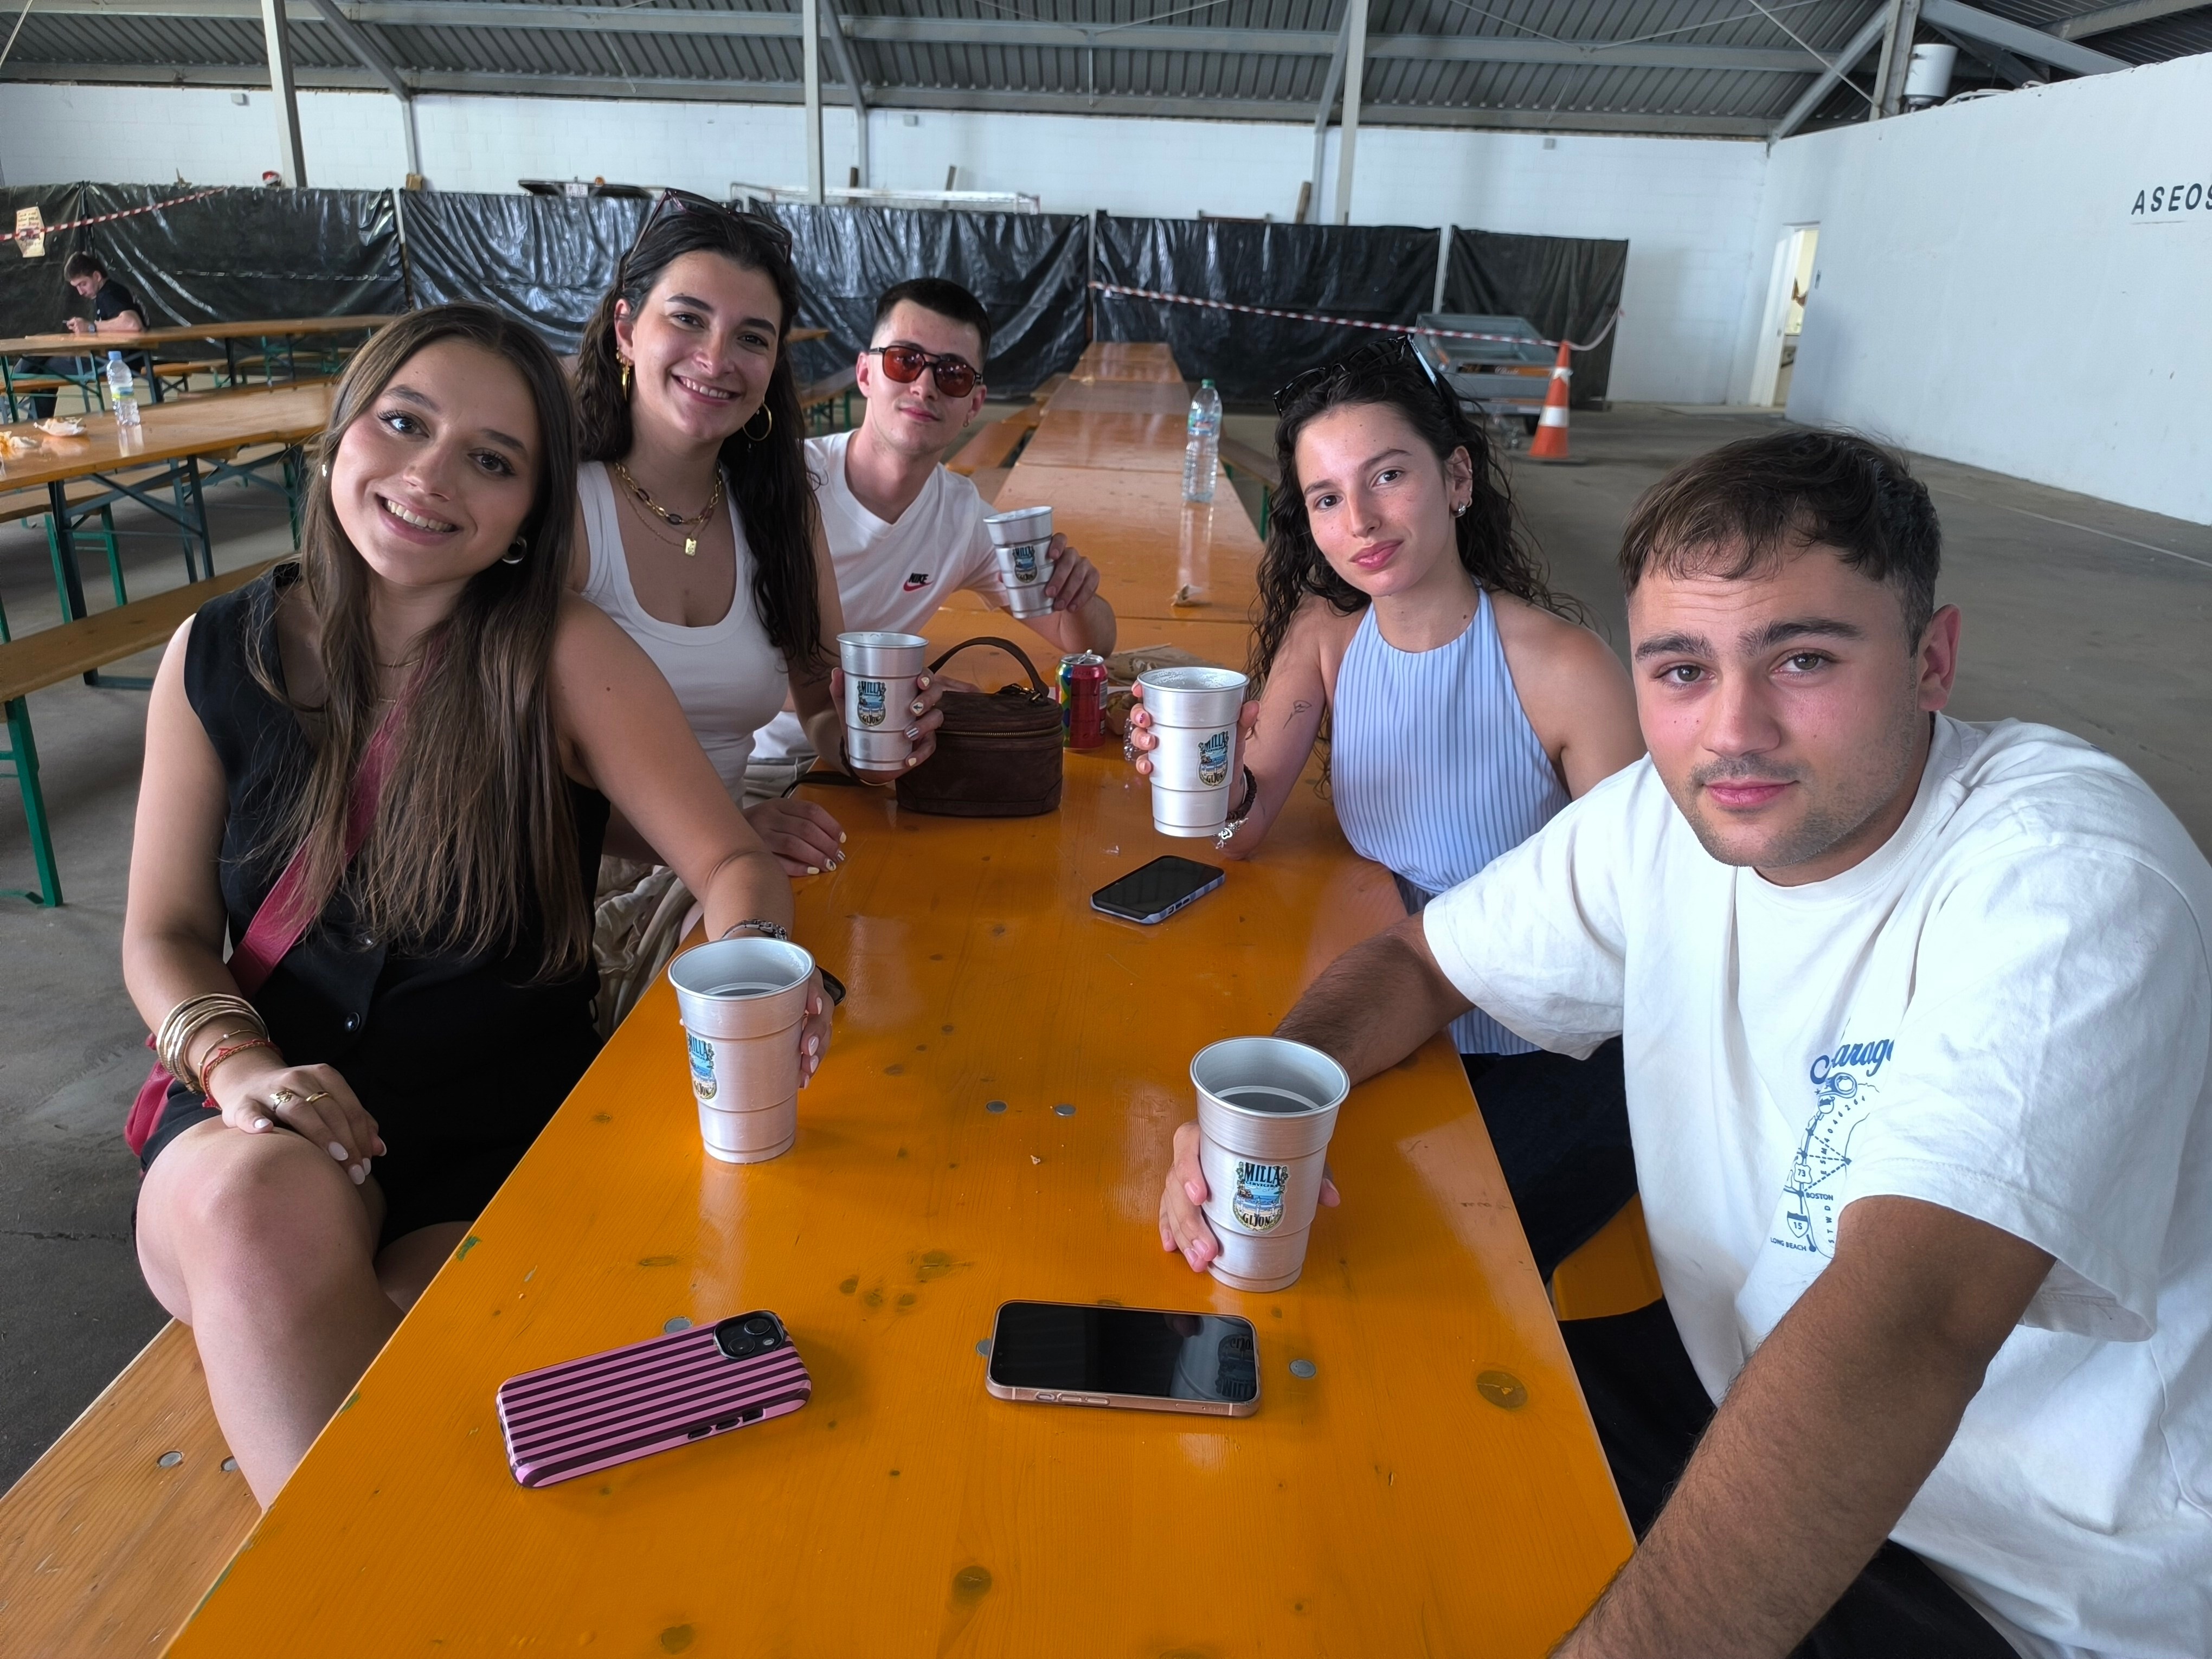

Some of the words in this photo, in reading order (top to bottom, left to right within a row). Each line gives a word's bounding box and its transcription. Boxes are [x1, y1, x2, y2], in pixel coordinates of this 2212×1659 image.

[909, 573, 929, 584] NIKE
[861, 681, 882, 697] MILLA
[1205, 731, 1226, 753] MILLA
[1244, 1162, 1282, 1186] MILLA
[1797, 1168, 1806, 1177] 73
[1805, 1192, 1834, 1201] BOSTON
[1793, 1221, 1803, 1230] 15
[1770, 1237, 1784, 1246] LONG
[1785, 1242, 1807, 1251] BEACH
